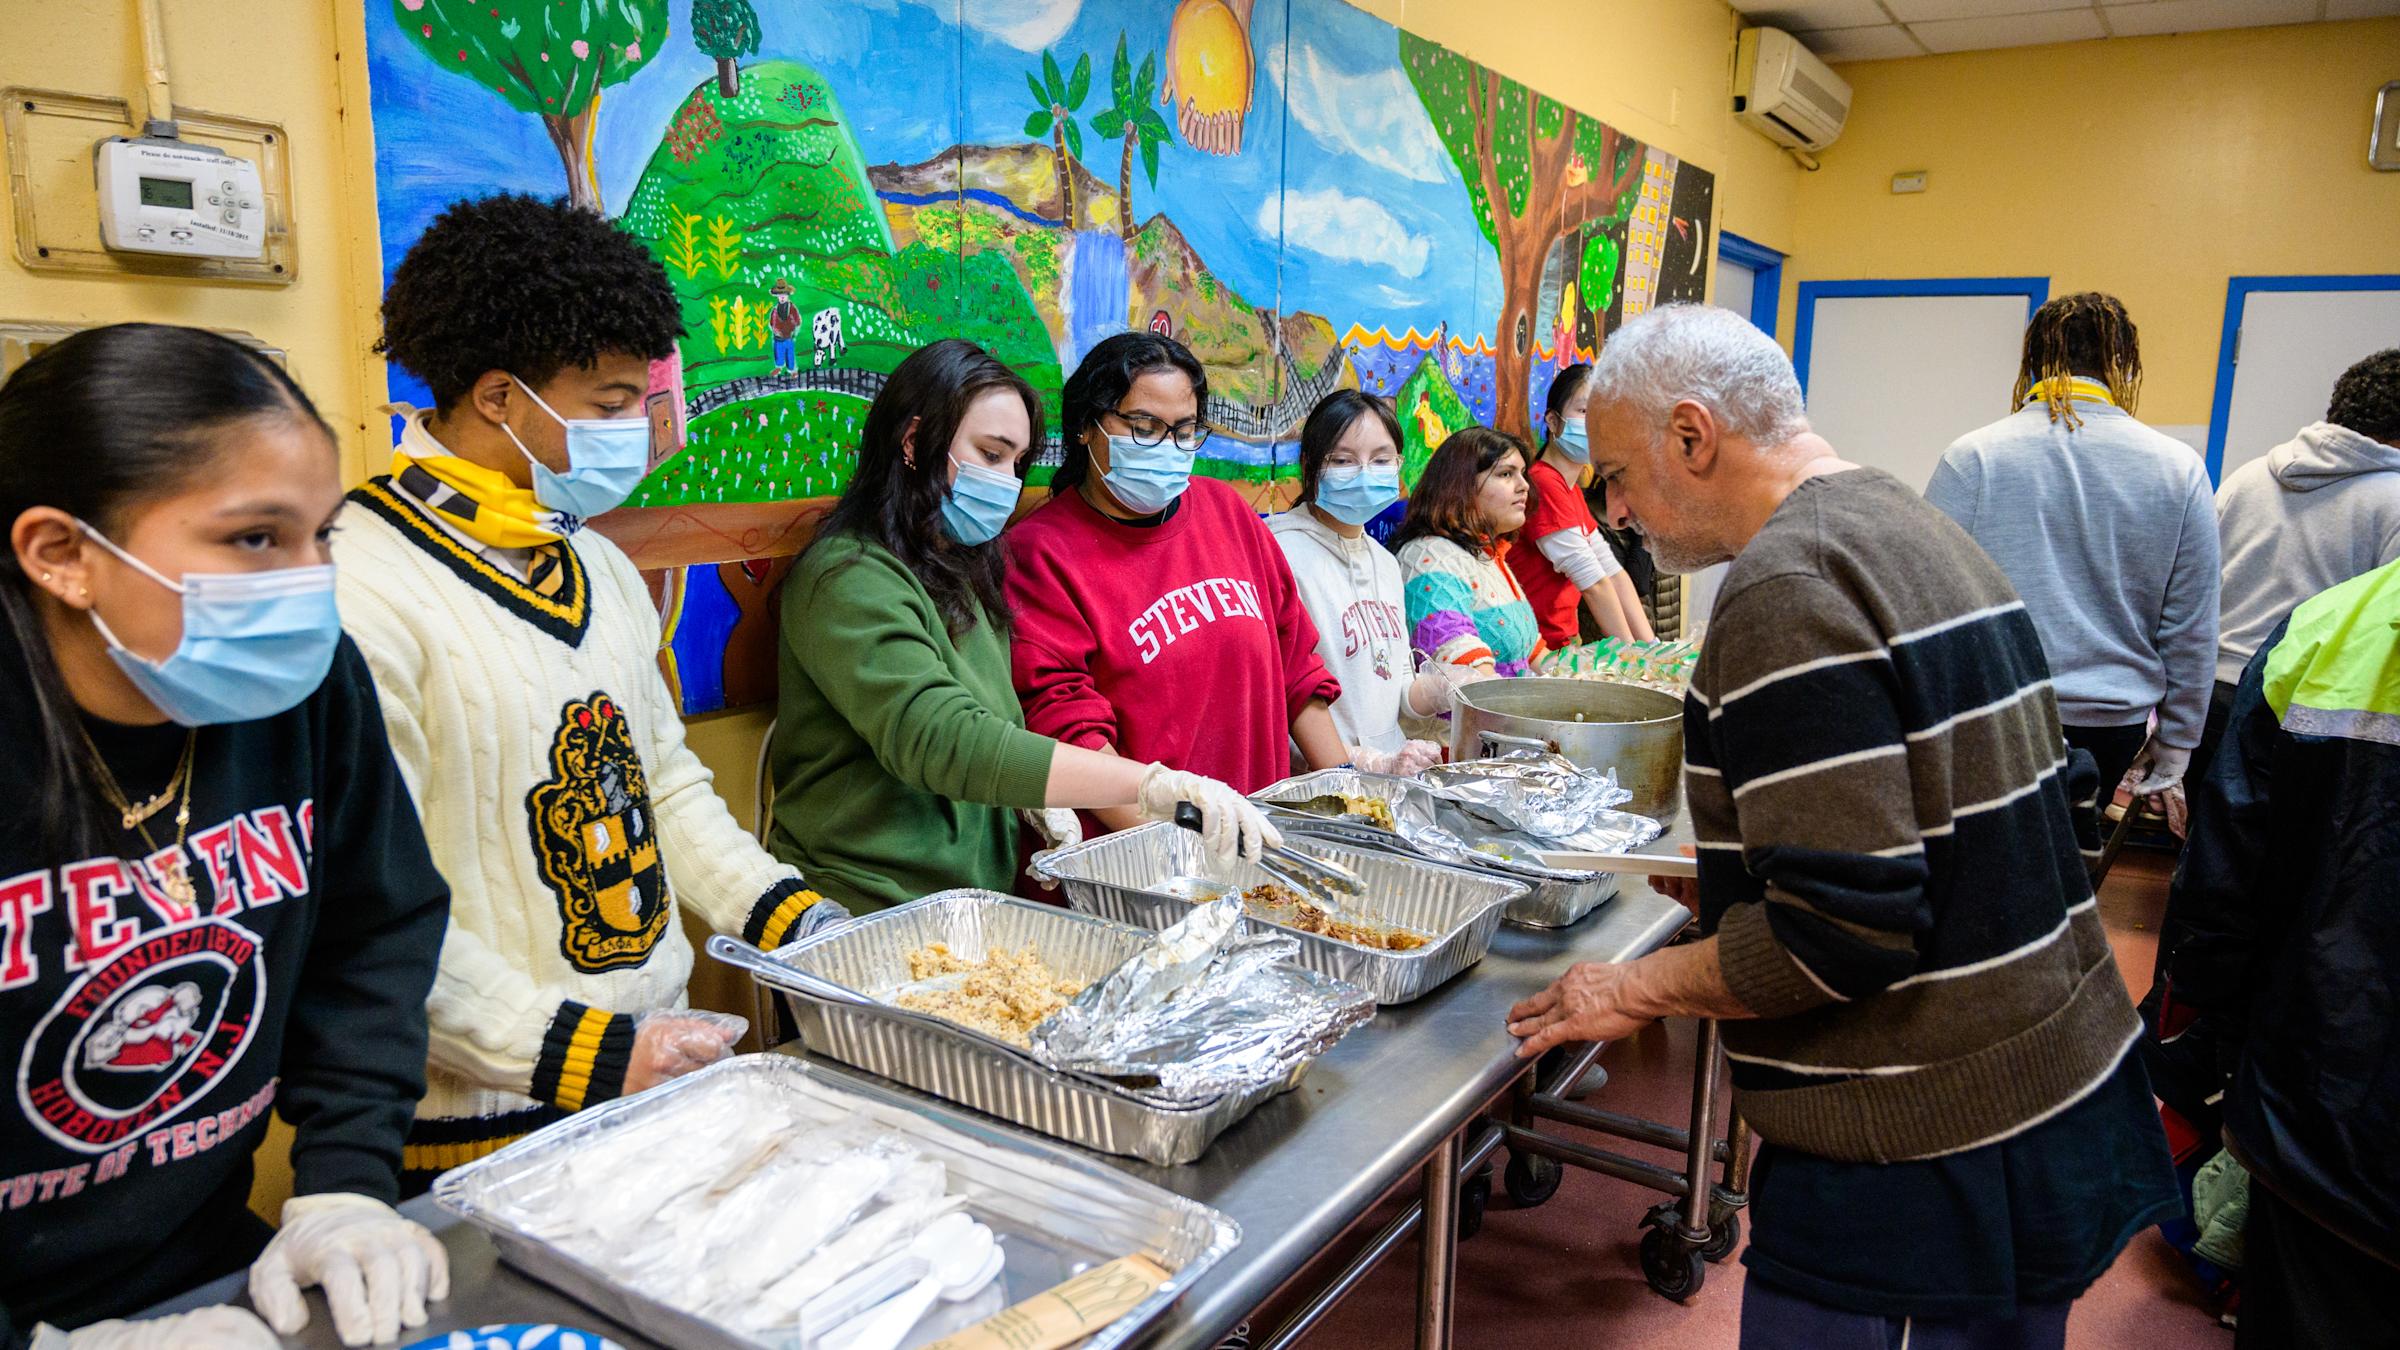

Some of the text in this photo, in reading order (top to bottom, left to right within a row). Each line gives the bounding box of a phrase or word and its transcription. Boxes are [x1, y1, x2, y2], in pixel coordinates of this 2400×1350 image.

[1128, 577, 1267, 665] STEVEN
[65, 928, 254, 1019] FOUNDED 1870
[30, 1076, 184, 1143] HOBOKEN
[94, 1140, 139, 1185] OF
